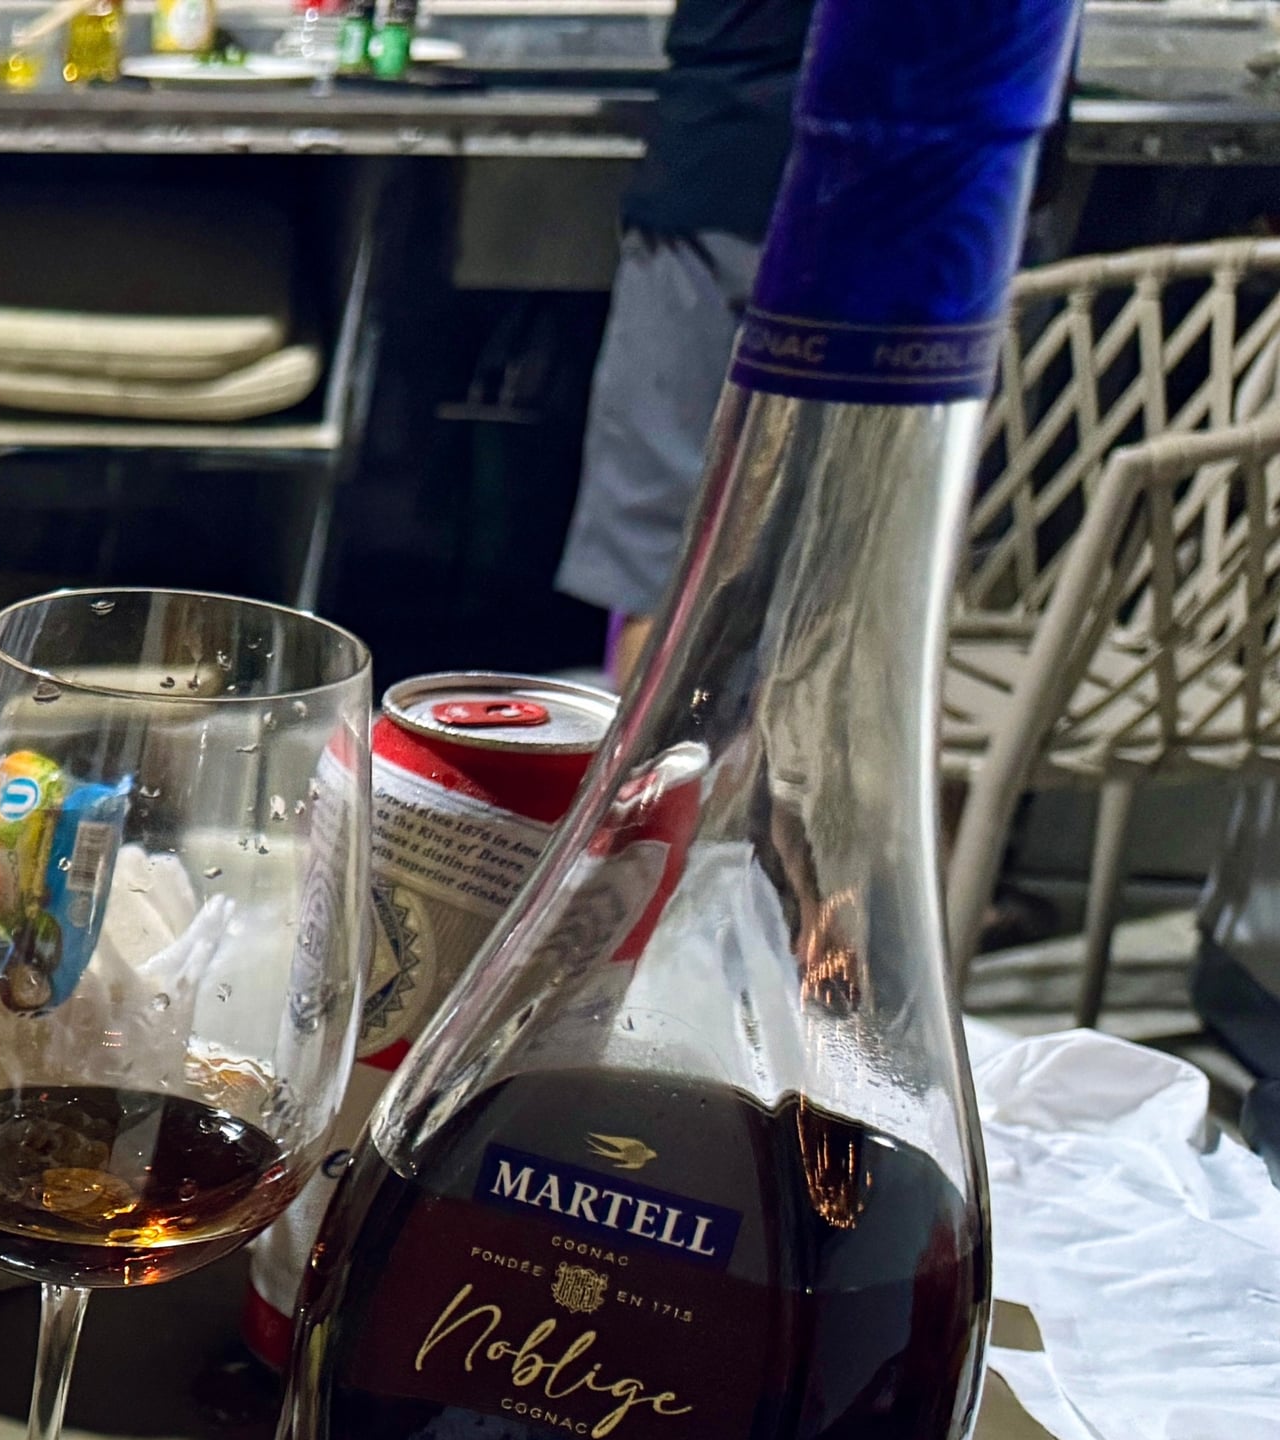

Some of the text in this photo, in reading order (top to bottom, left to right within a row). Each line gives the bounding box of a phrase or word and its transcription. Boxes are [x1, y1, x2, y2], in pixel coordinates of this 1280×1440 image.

[393, 814, 414, 832] the
[418, 825, 454, 848] King
[457, 842, 479, 856] of
[489, 1160, 716, 1257] MARTELL
[551, 1235, 629, 1267] COGNAC
[617, 1290, 643, 1308] EN
[414, 1283, 693, 1439] Noblige
[501, 1397, 590, 1436] COGNAC
